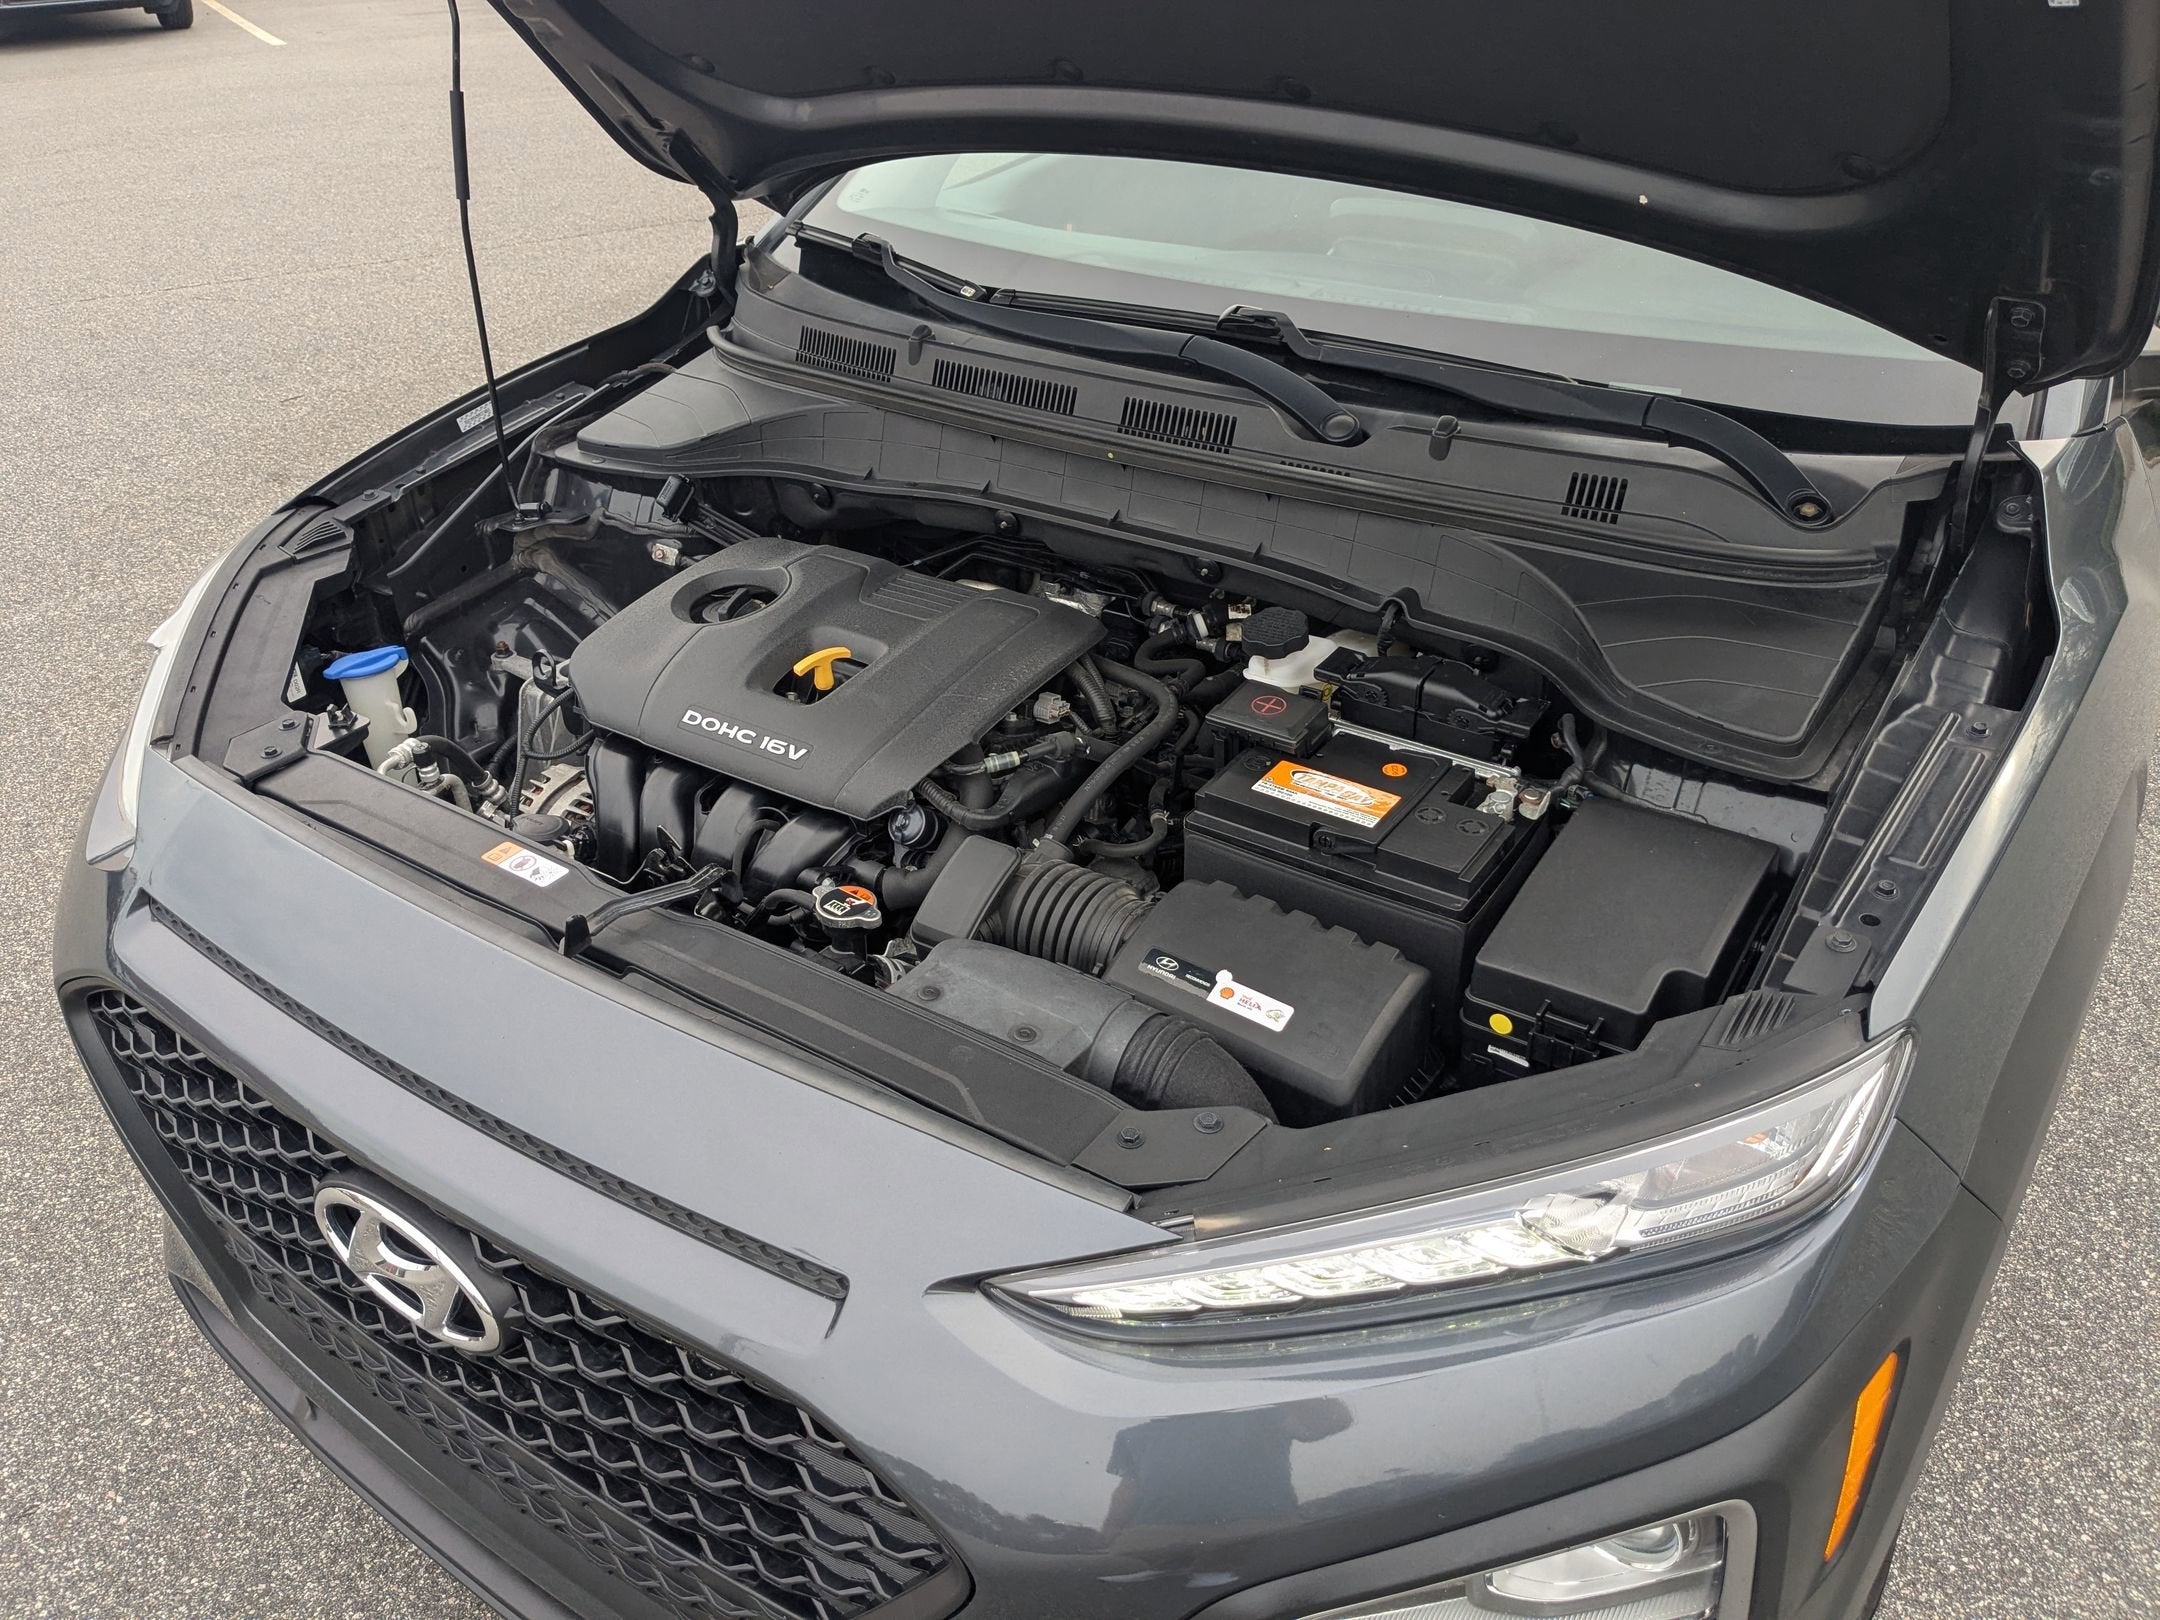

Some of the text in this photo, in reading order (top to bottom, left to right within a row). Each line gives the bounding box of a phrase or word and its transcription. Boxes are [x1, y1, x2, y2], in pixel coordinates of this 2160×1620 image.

[681, 709, 808, 761] DOHC 16V
[1297, 773, 1344, 794] TAMPA
[1147, 964, 1177, 980] HYUNDAI
